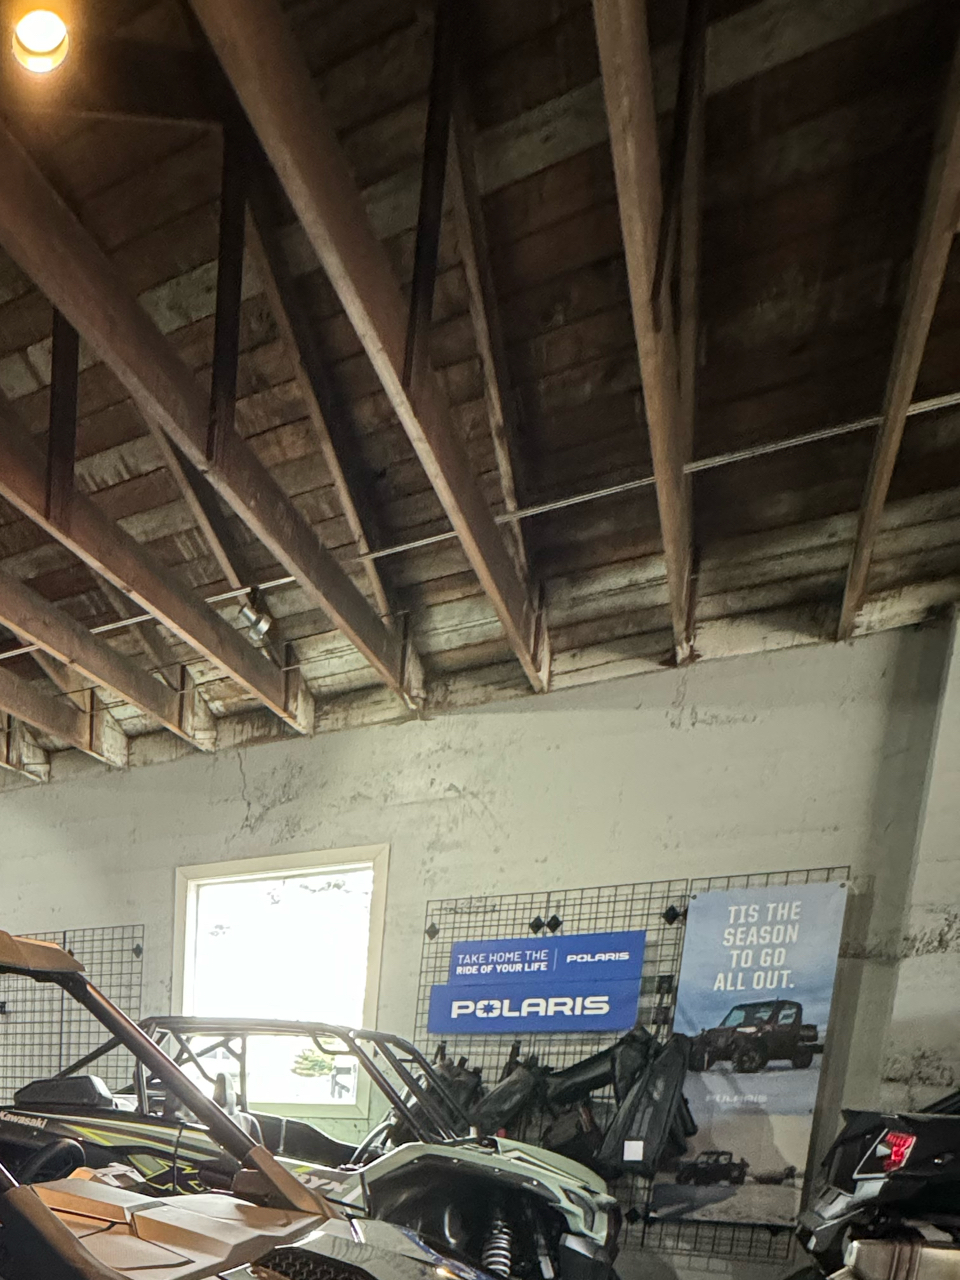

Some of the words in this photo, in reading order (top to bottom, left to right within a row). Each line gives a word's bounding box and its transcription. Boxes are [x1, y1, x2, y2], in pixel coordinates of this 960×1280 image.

[728, 905, 759, 924] TIS
[767, 901, 801, 921] THE
[723, 923, 799, 946] SEASON
[457, 954, 486, 964] TAKE
[489, 951, 522, 962] HOME
[526, 950, 549, 960] THE
[566, 952, 630, 962] POLARIS
[730, 950, 753, 968] TO
[760, 948, 786, 967] GO
[456, 965, 478, 975] RIDE
[480, 965, 493, 973] OF
[496, 963, 522, 973] YOUR
[524, 961, 548, 972] LIFE
[713, 972, 746, 991] ALL
[752, 970, 795, 989] OUT.
[451, 996, 610, 1018] POLARIS
